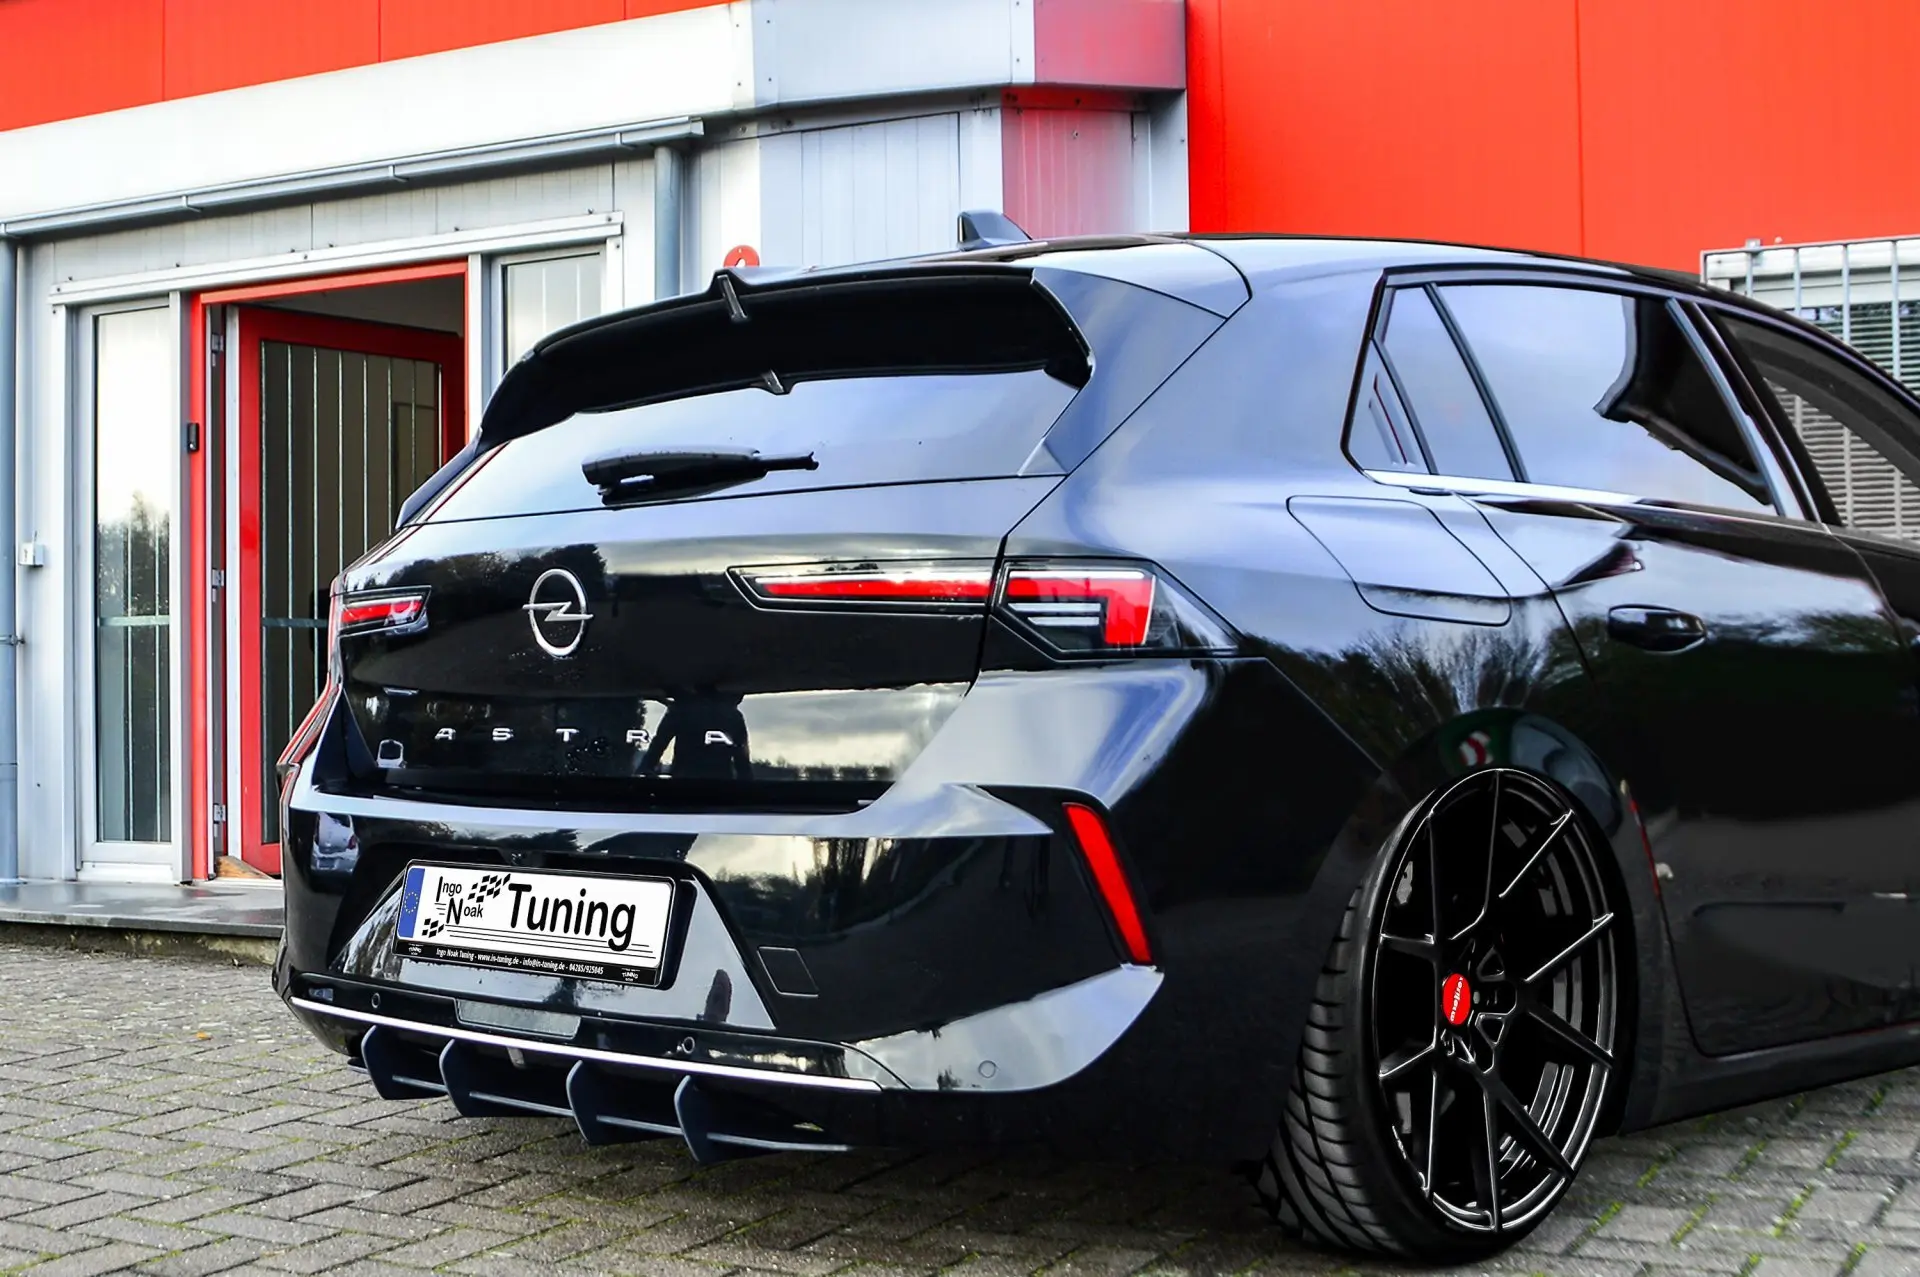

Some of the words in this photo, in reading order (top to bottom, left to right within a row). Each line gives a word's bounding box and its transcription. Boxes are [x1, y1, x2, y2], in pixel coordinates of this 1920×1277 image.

[435, 727, 734, 745] ASTRA
[436, 876, 462, 902] Ingo
[446, 898, 484, 925] Noak
[508, 883, 636, 951] Tuning
